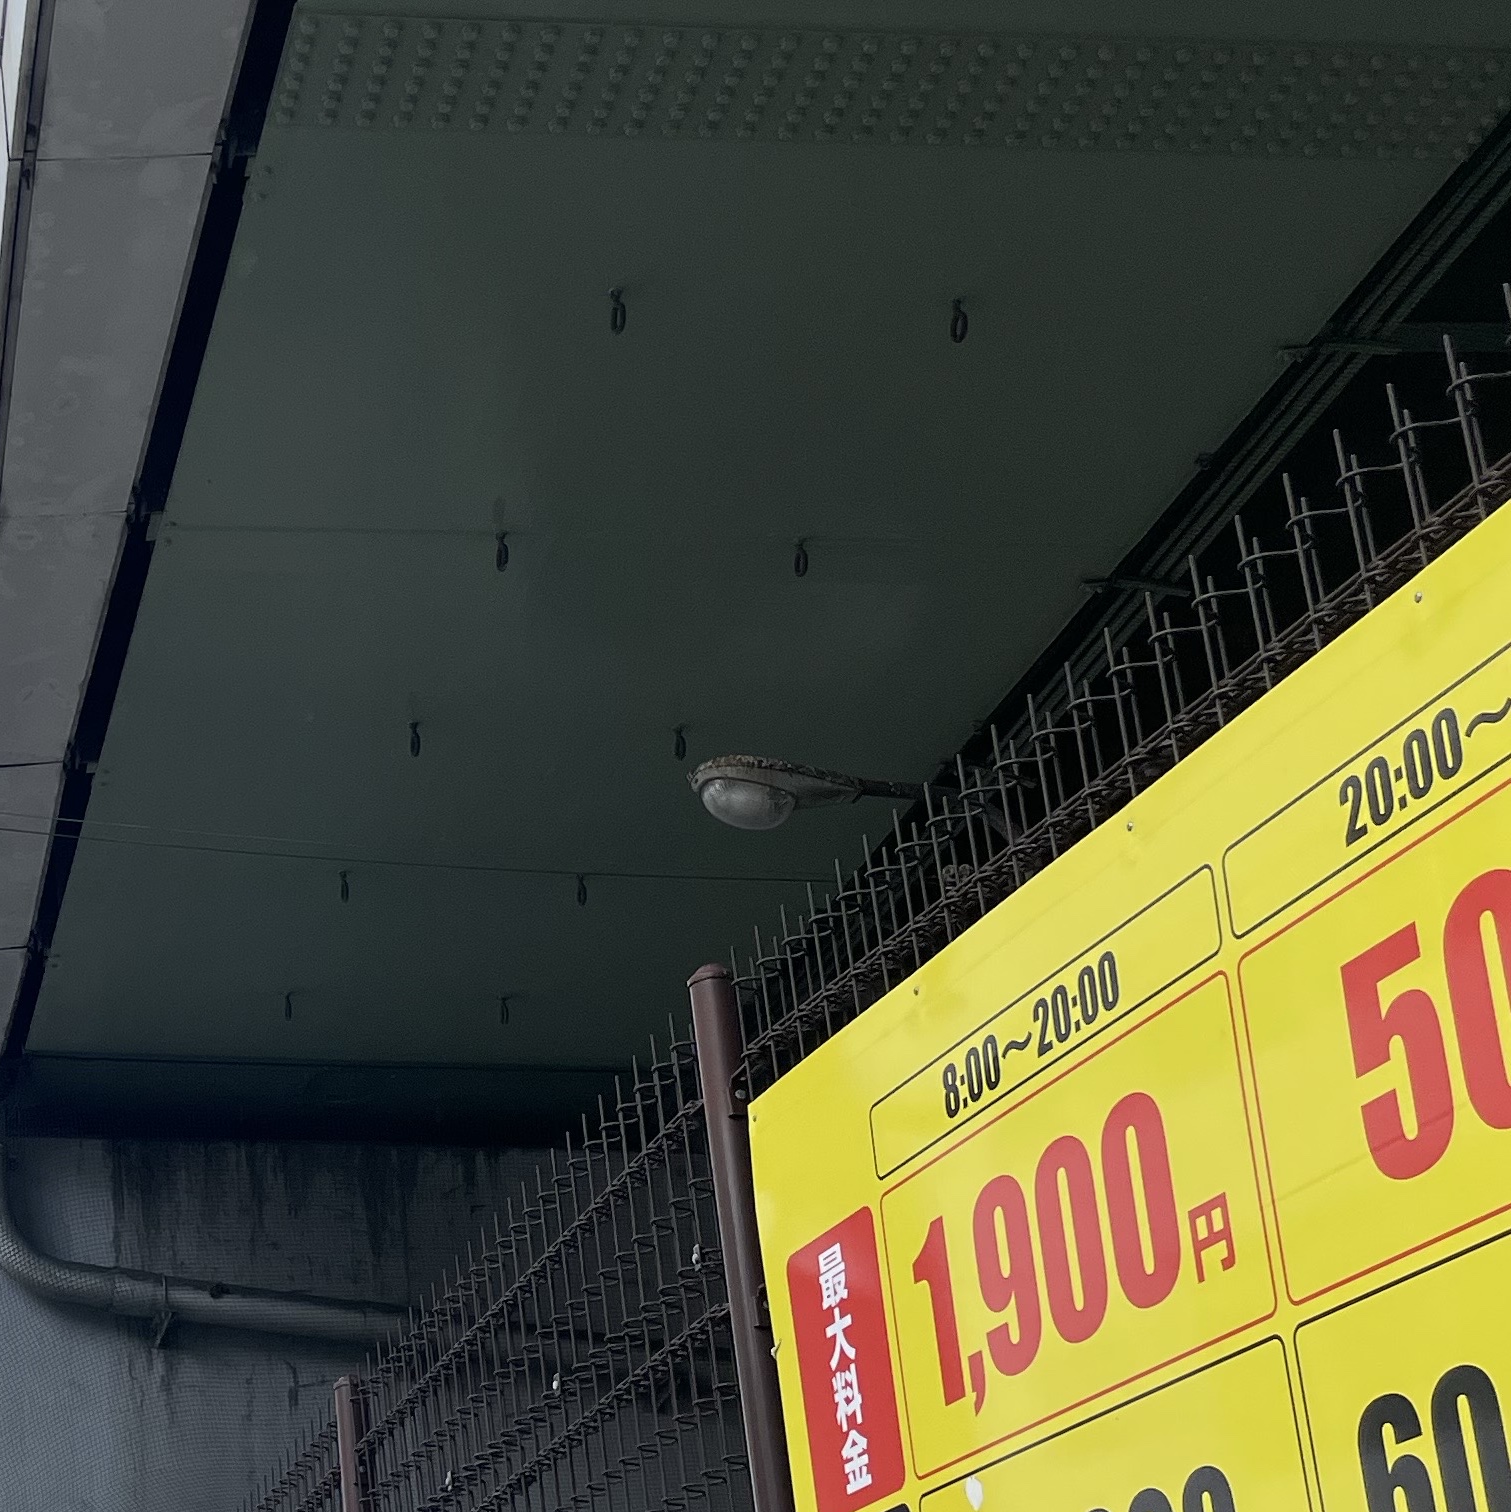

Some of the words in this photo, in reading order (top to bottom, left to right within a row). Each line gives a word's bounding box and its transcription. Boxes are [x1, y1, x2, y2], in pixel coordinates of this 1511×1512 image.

[817, 1242, 873, 1496] 最大料金
[912, 1091, 1236, 1417] 1,900円
